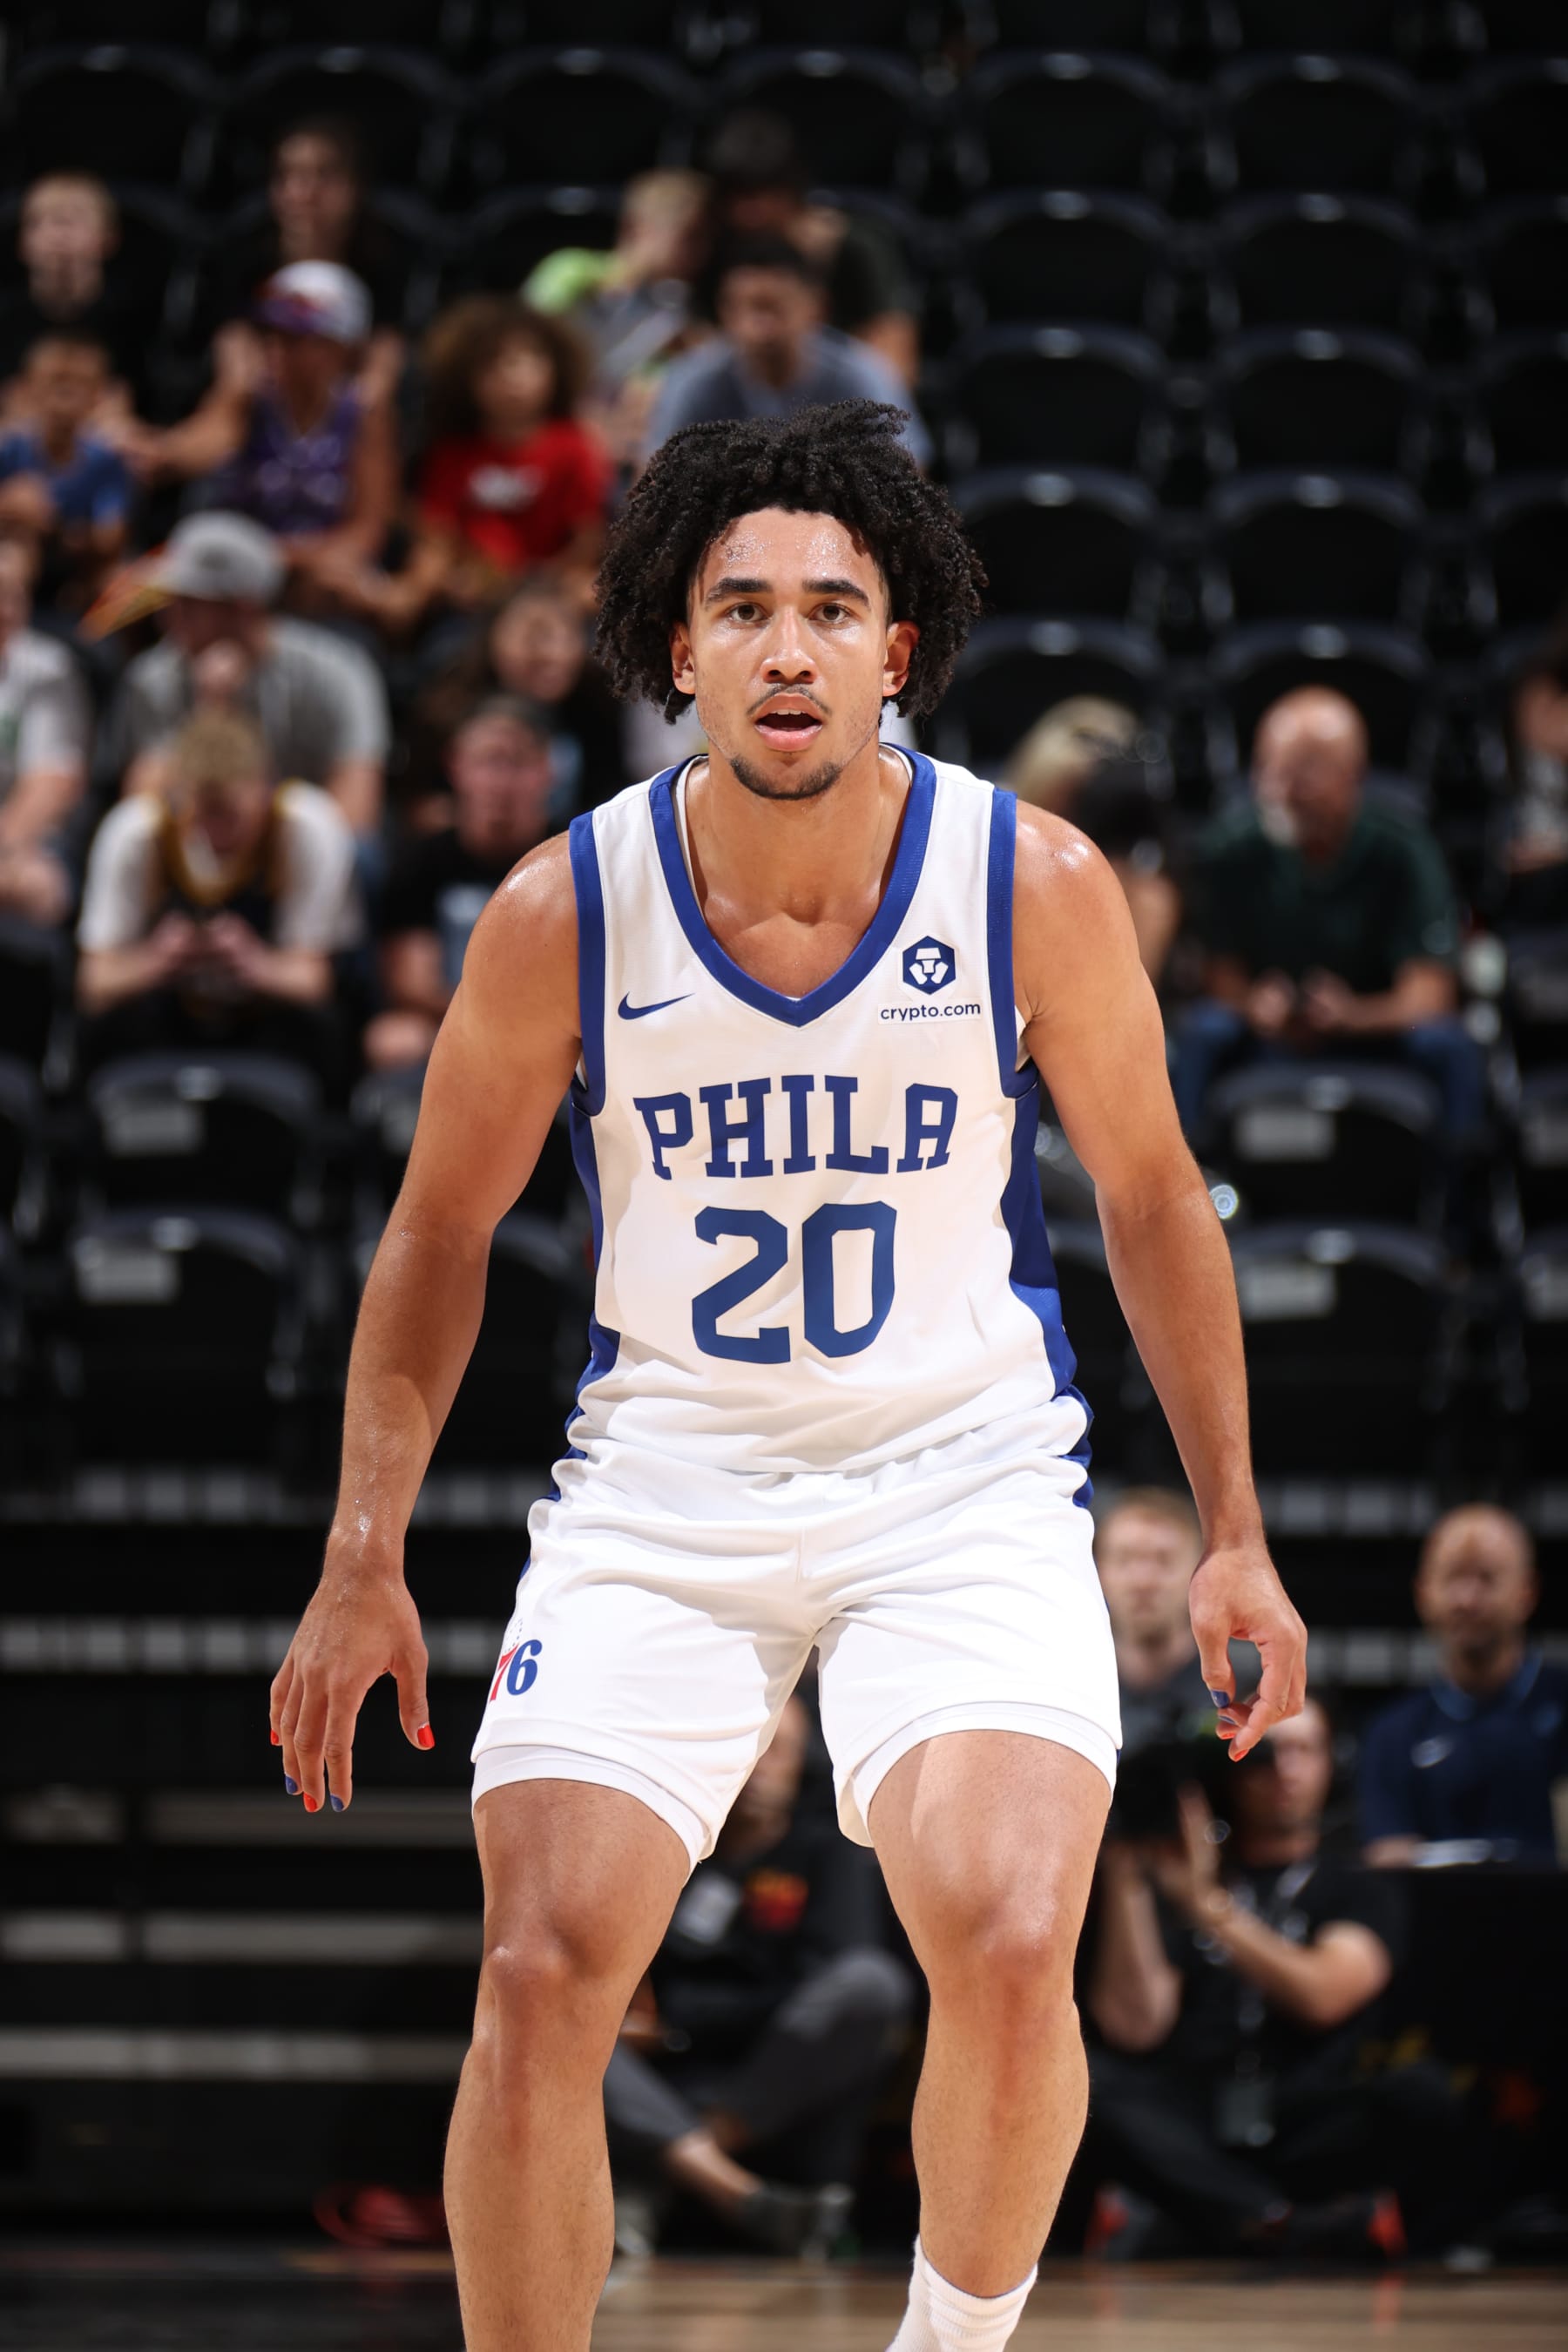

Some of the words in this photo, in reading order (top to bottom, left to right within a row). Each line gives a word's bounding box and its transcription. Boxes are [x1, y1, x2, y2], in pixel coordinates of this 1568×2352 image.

[880, 1003, 981, 1022] crypto.com
[632, 1074, 958, 1180] PHILA
[692, 1200, 897, 1364] 20
[490, 1639, 543, 1702] 76
